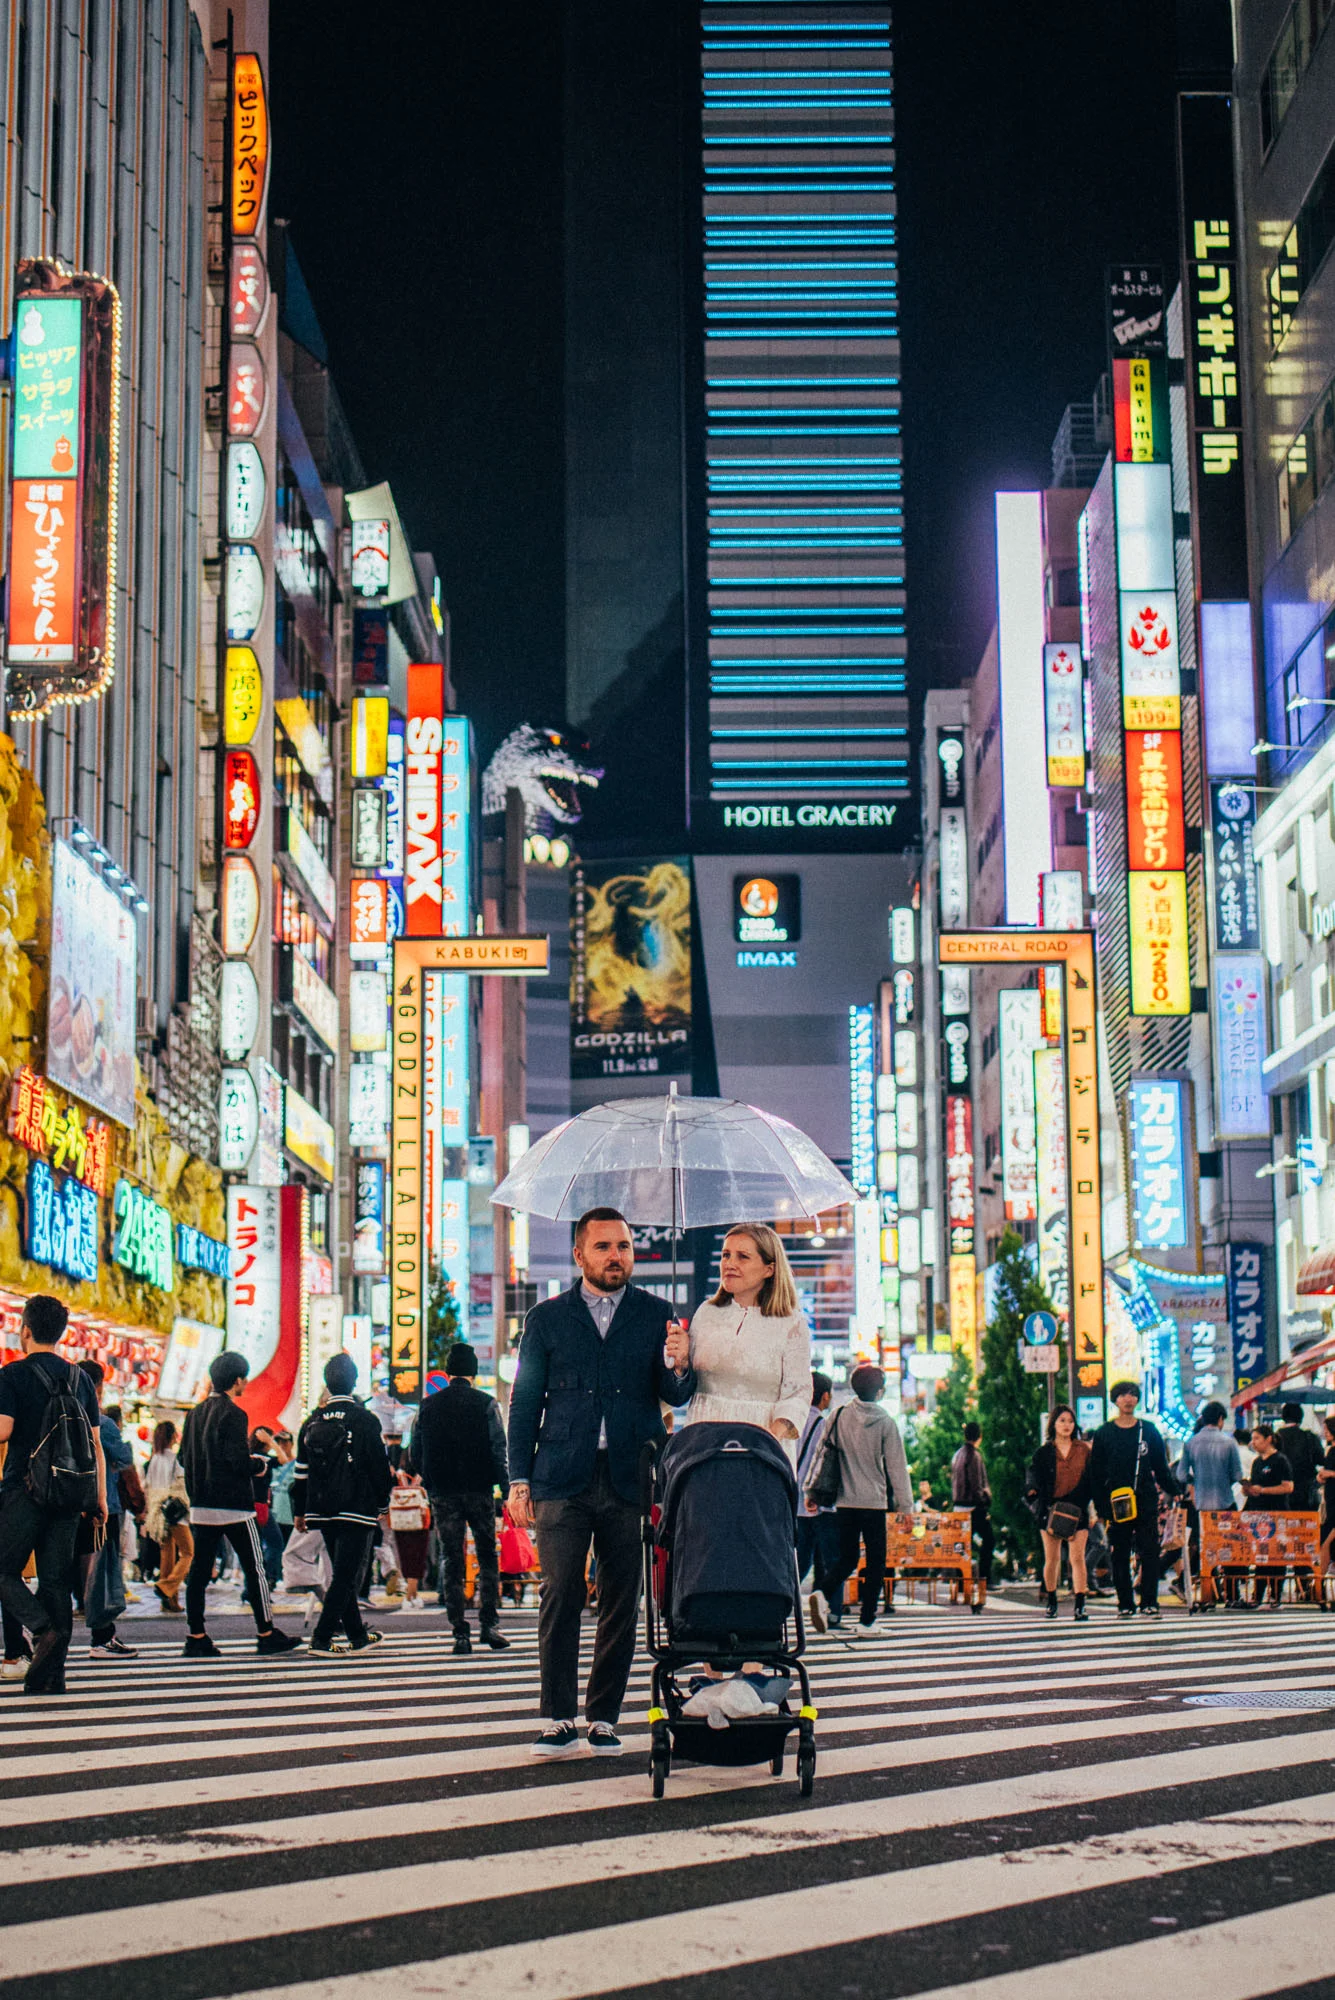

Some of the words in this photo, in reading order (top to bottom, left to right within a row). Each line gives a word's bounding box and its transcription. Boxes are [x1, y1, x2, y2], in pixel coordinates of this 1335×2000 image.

[1194, 220, 1239, 474] ドン・キホーテ
[25, 501, 65, 642] ひょうたん
[406, 716, 443, 905] SHIDAX
[724, 806, 795, 828] HOTEL
[796, 804, 897, 827] GRACERY
[736, 951, 798, 968] IMAX
[946, 940, 1020, 953] CENTRAL
[1025, 940, 1068, 953] ROAD
[575, 1029, 688, 1048] GODZILLA
[1229, 1019, 1243, 1079] STAGE
[1243, 1019, 1257, 1065] IDOL
[397, 1005, 417, 1206] GODZILLA
[1071, 1028, 1096, 1299] ゴジラロード
[1140, 1087, 1180, 1240] カラオケ
[234, 1198, 259, 1307] トラノコ
[397, 1231, 417, 1328] ROAD
[1235, 1249, 1264, 1372] カラオケ
